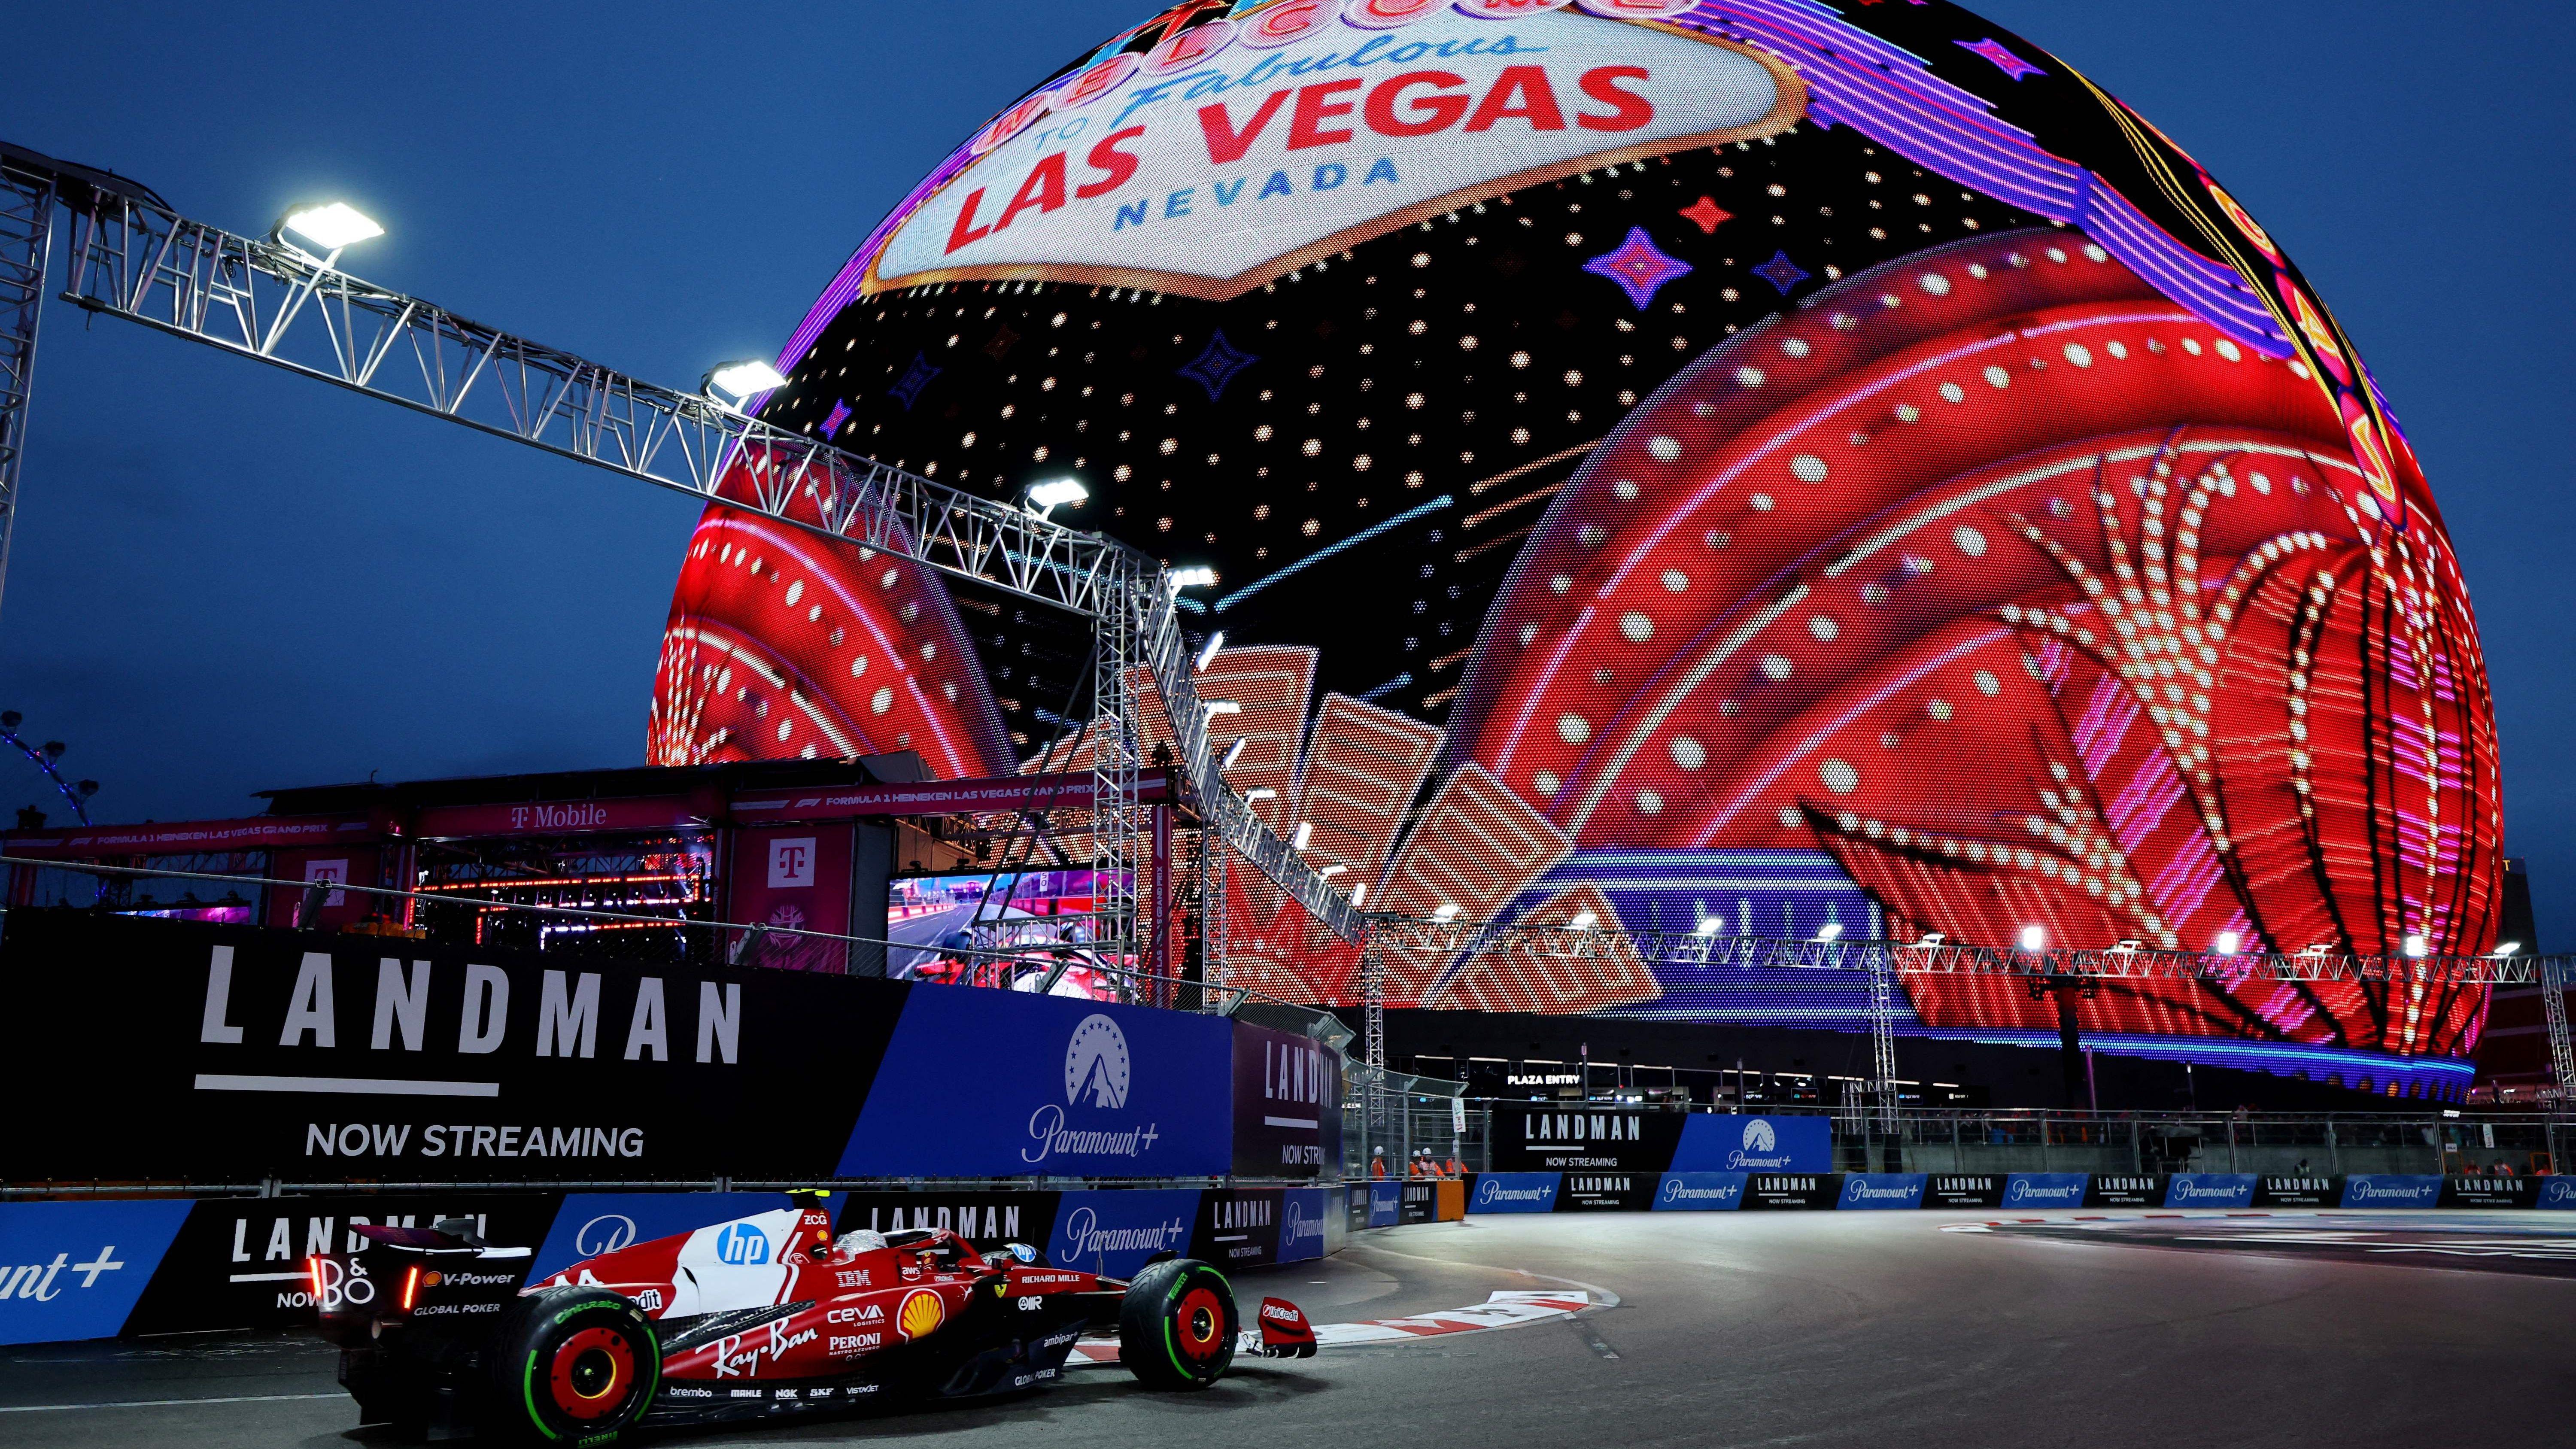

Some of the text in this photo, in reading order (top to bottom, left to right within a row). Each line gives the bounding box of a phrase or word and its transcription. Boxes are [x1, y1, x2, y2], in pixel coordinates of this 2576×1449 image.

[1034, 34, 1551, 150] TO Fabulous
[945, 65, 1653, 256] LAS VEGAS
[1114, 157, 1400, 231] NEVADA
[826, 796, 881, 805] FORMULA
[884, 794, 890, 802] 1
[893, 792, 952, 802] HEINEKEN
[954, 790, 977, 800] LAS
[980, 788, 1021, 799] VEGAS
[1066, 784, 1094, 794] PRIX
[534, 803, 606, 828] Mobile
[97, 835, 147, 845] FORMULA
[156, 832, 207, 841] HEINEKEN
[209, 831, 230, 839] LAS
[231, 827, 261, 838] VEGAS
[262, 825, 301, 834] GRAND
[302, 824, 328, 833] PRIX
[201, 945, 741, 1064] LANDMAN
[1507, 1075, 1580, 1084] PLAZA ENTRY
[1021, 1104, 1159, 1163] Paramount+
[1525, 1114, 1639, 1140] LANDMAN
[305, 1123, 644, 1157] NOW STREAMING
[1282, 1145, 1302, 1164] NOW
[1546, 1157, 1617, 1167] NOW STREAMING
[1726, 1150, 1791, 1170] Paramount+
[1571, 1177, 1631, 1191] LANDMAN
[1663, 1179, 1737, 1203] Paramount+
[1758, 1177, 1816, 1191] LANDMAN
[1848, 1179, 1918, 1202] Paramount+
[1937, 1177, 1992, 1190] LANDMAN
[2011, 1179, 2079, 1201] Paramount+
[2098, 1178, 2154, 1190] LANDMAN
[2175, 1179, 2247, 1200] Paramount+
[2267, 1178, 2329, 1191] LANDMAN
[2352, 1180, 2432, 1200] Paramount+
[2455, 1179, 2523, 1191] LANDMAN
[1404, 1186, 1429, 1202] LANDMAN
[1480, 1180, 1552, 1205] Paramount+
[804, 1215, 827, 1225] ZCG
[871, 1206, 1019, 1239] LANDMAN
[1214, 1200, 1270, 1229] LANDMAN
[1061, 1207, 1183, 1263] Paramount+
[724, 1223, 764, 1265] hp
[1229, 1246, 1262, 1258] NOW STREAMING
[443, 1273, 515, 1286] V-Power
[835, 1270, 872, 1287] IBM
[902, 1267, 920, 1275] aws
[1022, 1275, 1055, 1284] RICHARD
[414, 1303, 501, 1316] GLOBAL POKER
[1270, 1306, 1298, 1321] UniCredit
[854, 1318, 885, 1327] LOGISTICS
[829, 1332, 881, 1350] PERONI
[1044, 1334, 1074, 1347] ambipar
[1035, 1368, 1055, 1381] POKER
[670, 1386, 712, 1398] brembo
[731, 1389, 762, 1397] MAHLE
[775, 1389, 798, 1398] NGK
[810, 1388, 834, 1397] SKF
